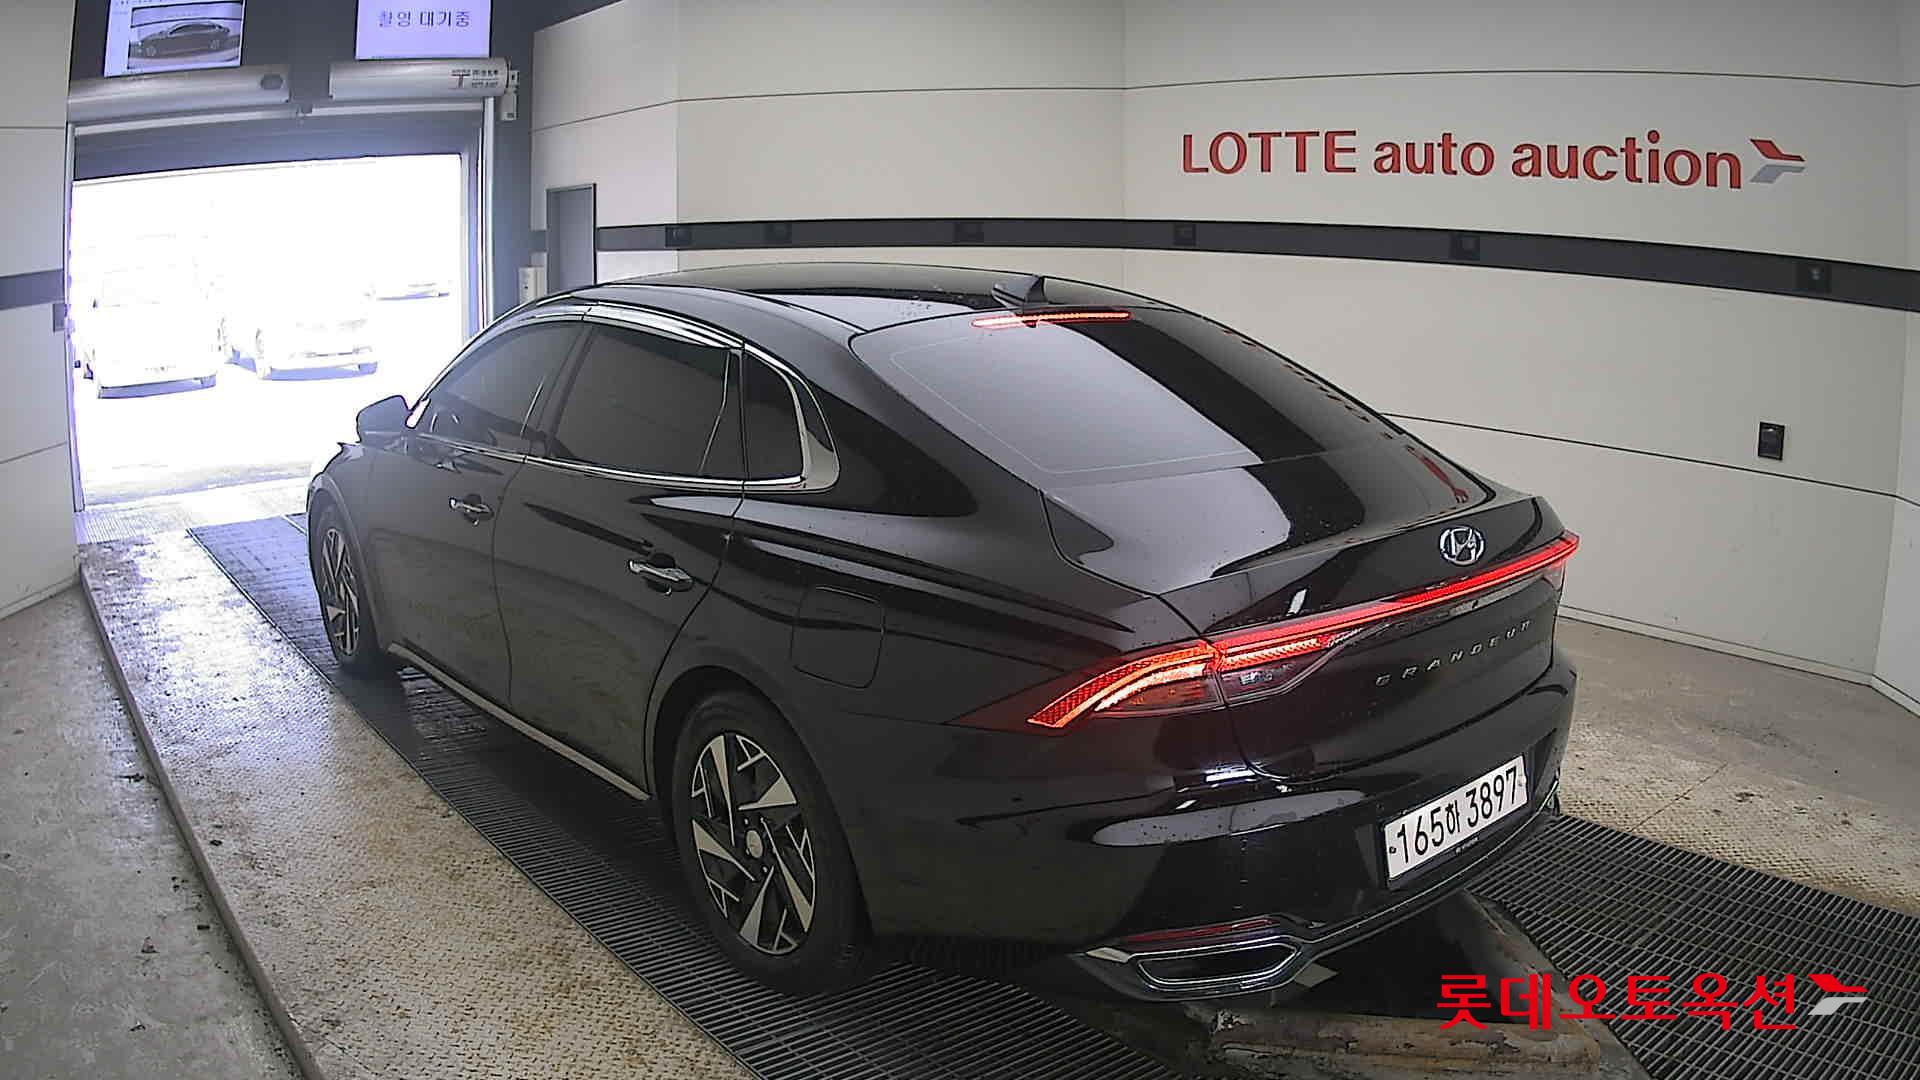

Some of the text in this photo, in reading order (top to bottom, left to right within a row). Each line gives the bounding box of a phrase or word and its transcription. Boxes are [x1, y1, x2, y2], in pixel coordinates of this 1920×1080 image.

[419, 10, 471, 28] 대기중
[1182, 130, 1742, 189] LOTTE auto auction
[1375, 619, 1533, 687] GRANDEUR
[1397, 765, 1519, 864] 165하 3897
